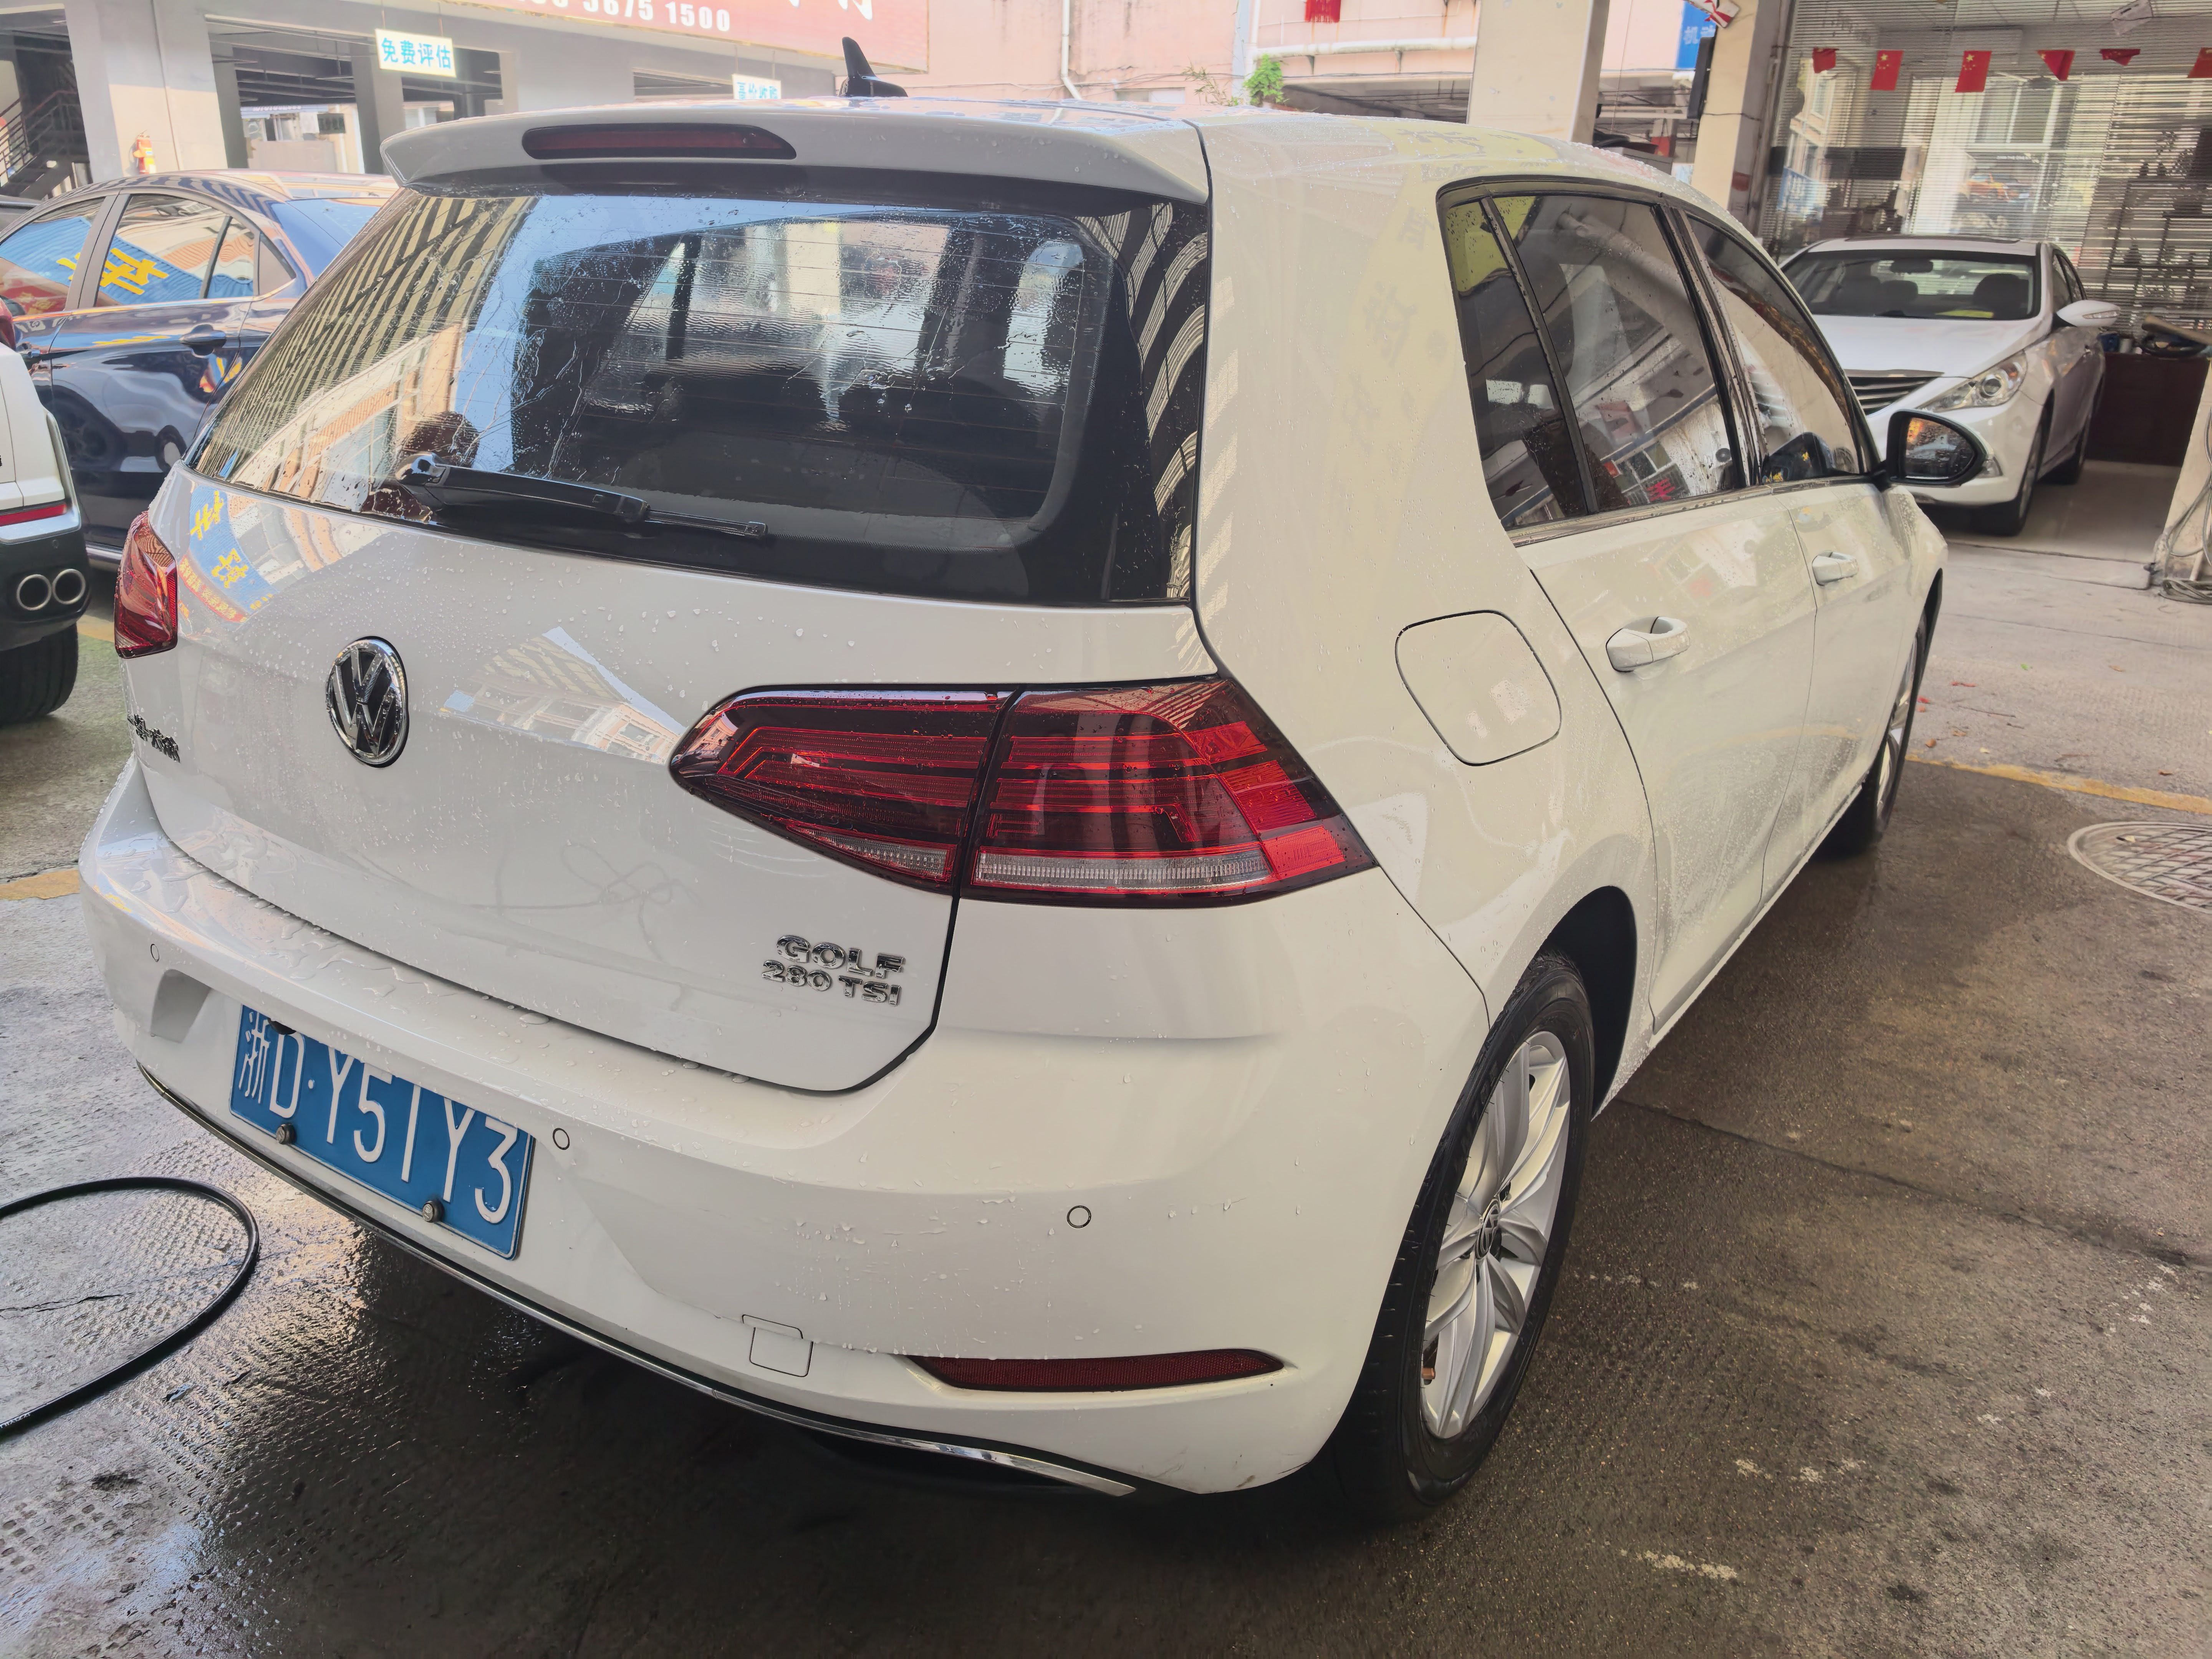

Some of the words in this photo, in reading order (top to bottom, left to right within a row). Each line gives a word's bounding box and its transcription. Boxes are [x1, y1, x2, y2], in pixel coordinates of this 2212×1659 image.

[665, 1, 730, 32] 1500
[381, 37, 451, 69] 免费评估
[776, 934, 905, 979] GOLF
[761, 959, 833, 992] 280
[838, 974, 901, 1006] TSI
